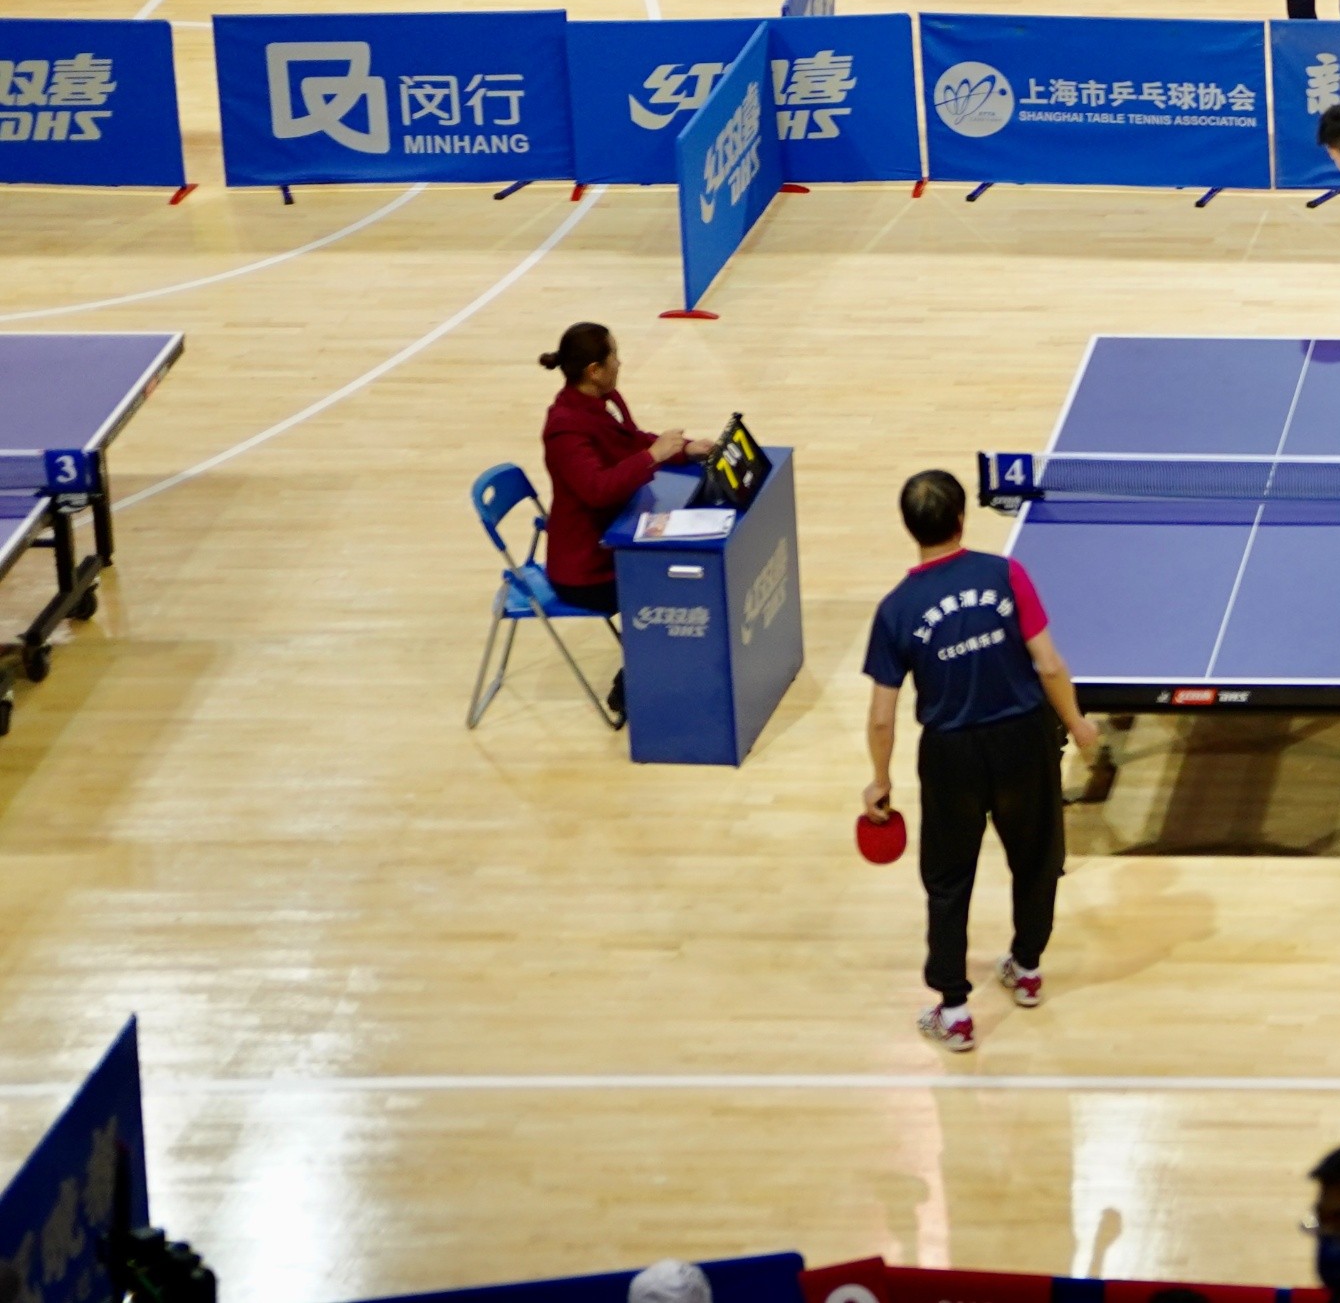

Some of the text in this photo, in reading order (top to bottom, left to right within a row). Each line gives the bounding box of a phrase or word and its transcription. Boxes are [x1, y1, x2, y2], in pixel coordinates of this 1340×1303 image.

[399, 73, 525, 127] 闵行
[629, 50, 858, 130] 红喜
[1019, 77, 1257, 113] 上海市乒乓球协会
[777, 107, 853, 140] HS
[1019, 110, 1257, 128] SHANGHAI TABLE TENNIS ASSOCIATION
[403, 133, 530, 155] MINHANG
[55, 455, 79, 485] 3
[1003, 459, 1026, 486] 4
